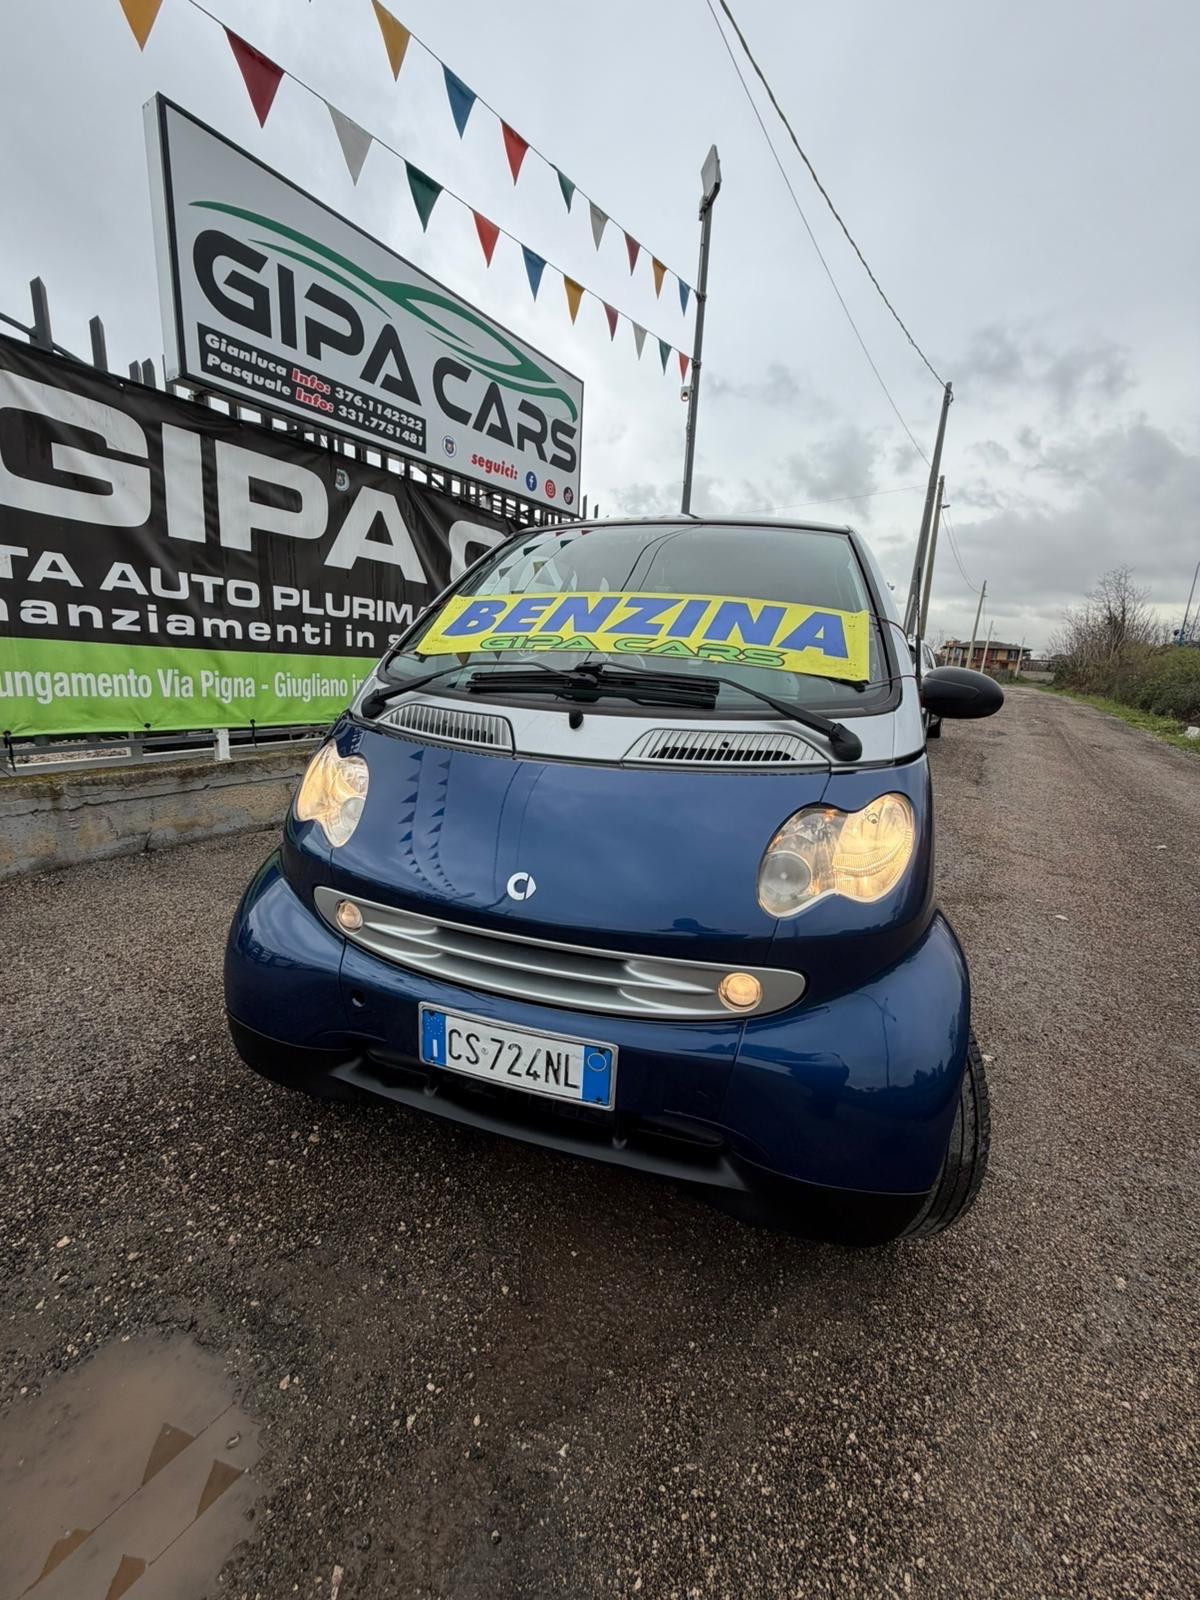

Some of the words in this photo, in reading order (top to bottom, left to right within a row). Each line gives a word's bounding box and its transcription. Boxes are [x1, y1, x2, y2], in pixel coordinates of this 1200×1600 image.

[193, 229, 422, 406] GIPA
[432, 357, 578, 473] CARS
[205, 333, 287, 376] Gianluca
[292, 367, 331, 395] Info:
[207, 353, 291, 396] Pasquale
[295, 387, 334, 413] Info:
[0, 368, 428, 585] GIPA
[471, 453, 518, 480] seguici:
[99, 561, 261, 609] AUTO
[346, 625, 375, 648] in
[442, 597, 849, 659] BENZINA
[480, 633, 598, 652] GIPA
[613, 636, 790, 669] CARS
[157, 668, 194, 698] Via
[200, 670, 256, 704] Pigna
[274, 671, 348, 703] Giugliano
